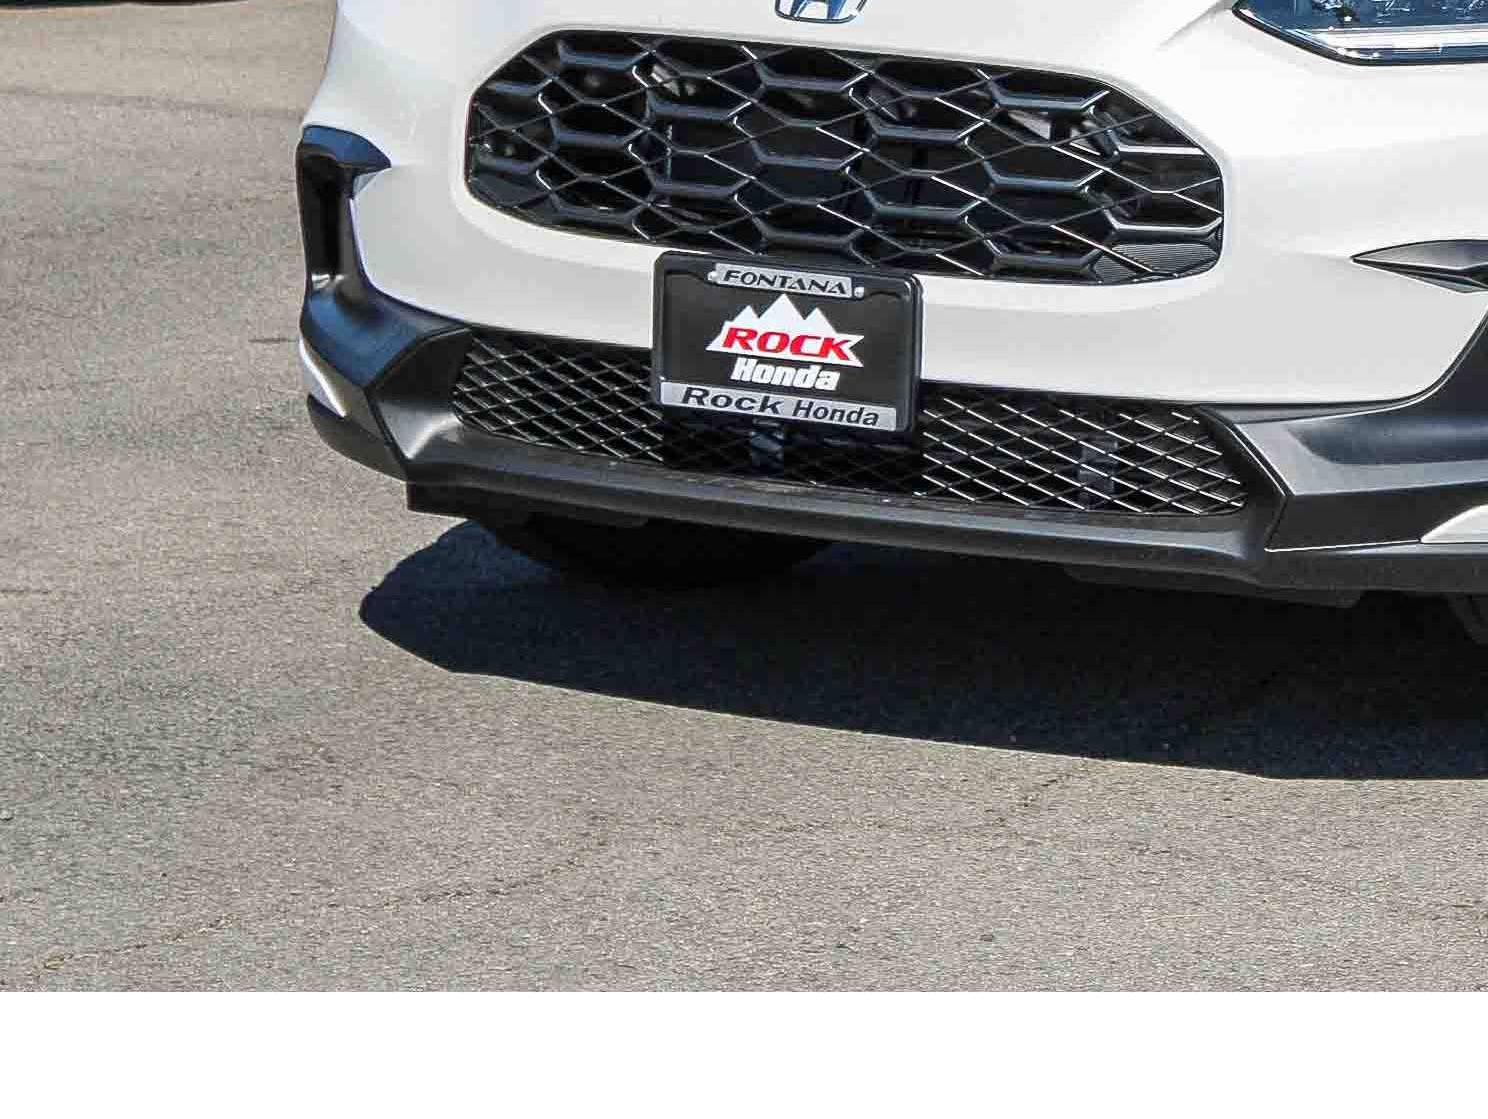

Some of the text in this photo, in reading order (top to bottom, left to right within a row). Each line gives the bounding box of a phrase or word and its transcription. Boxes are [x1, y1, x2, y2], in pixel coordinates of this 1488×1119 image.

[723, 269, 848, 296] FONTANA
[722, 327, 850, 361] ROCK
[730, 357, 841, 391] Honda
[681, 386, 880, 427] Rock Honda
